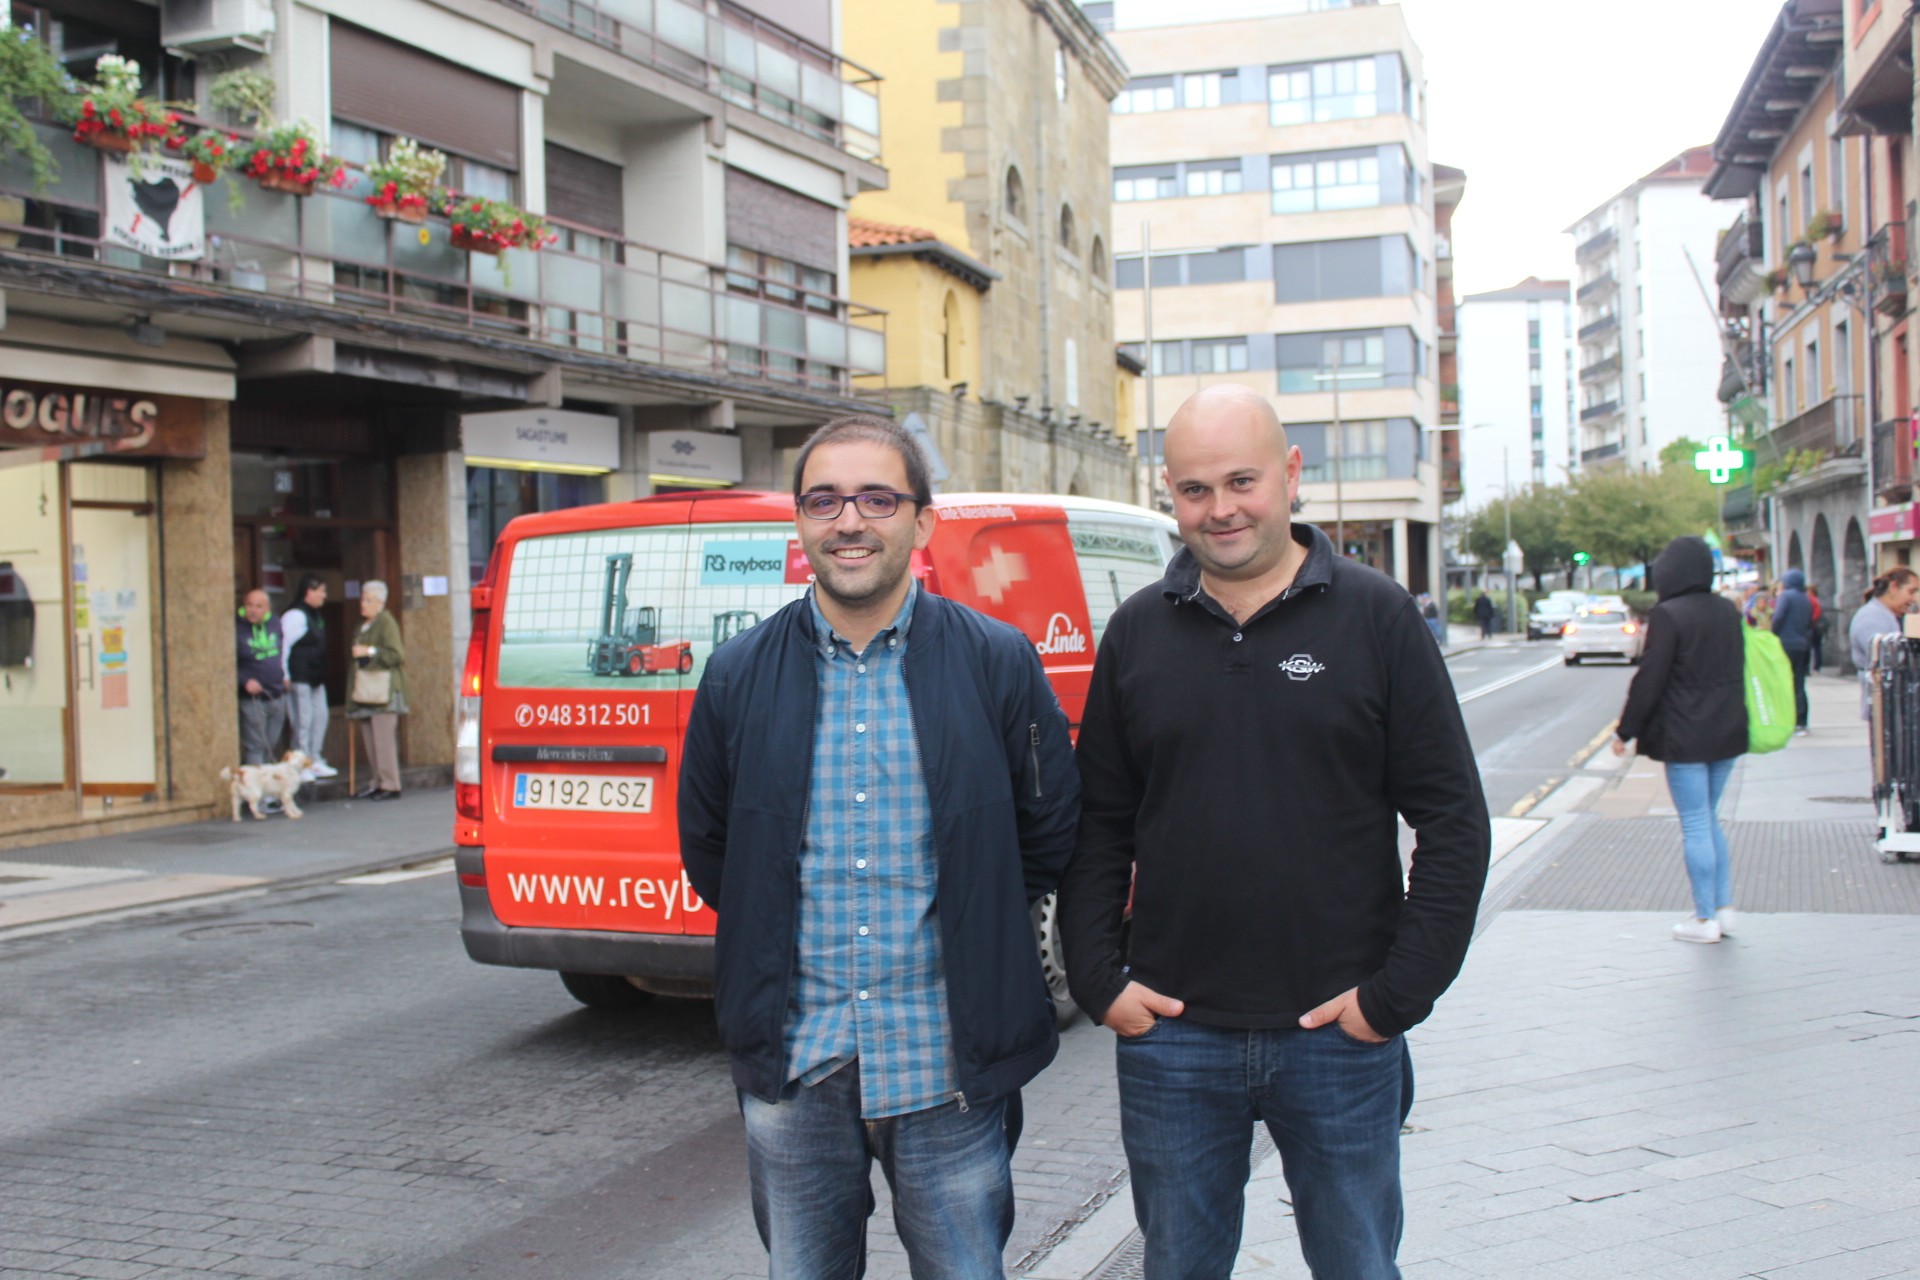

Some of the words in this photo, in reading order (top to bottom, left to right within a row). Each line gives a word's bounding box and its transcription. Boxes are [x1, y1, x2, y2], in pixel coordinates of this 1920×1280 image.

[0, 389, 158, 449] OGUES
[729, 557, 782, 576] reybesa
[1035, 612, 1086, 655] Linde
[537, 704, 572, 726] 948
[575, 704, 611, 726] 312
[615, 704, 650, 726] 501
[536, 747, 615, 761] Mercedes-Benz
[530, 778, 590, 805] 9192
[600, 781, 647, 808] CSZ
